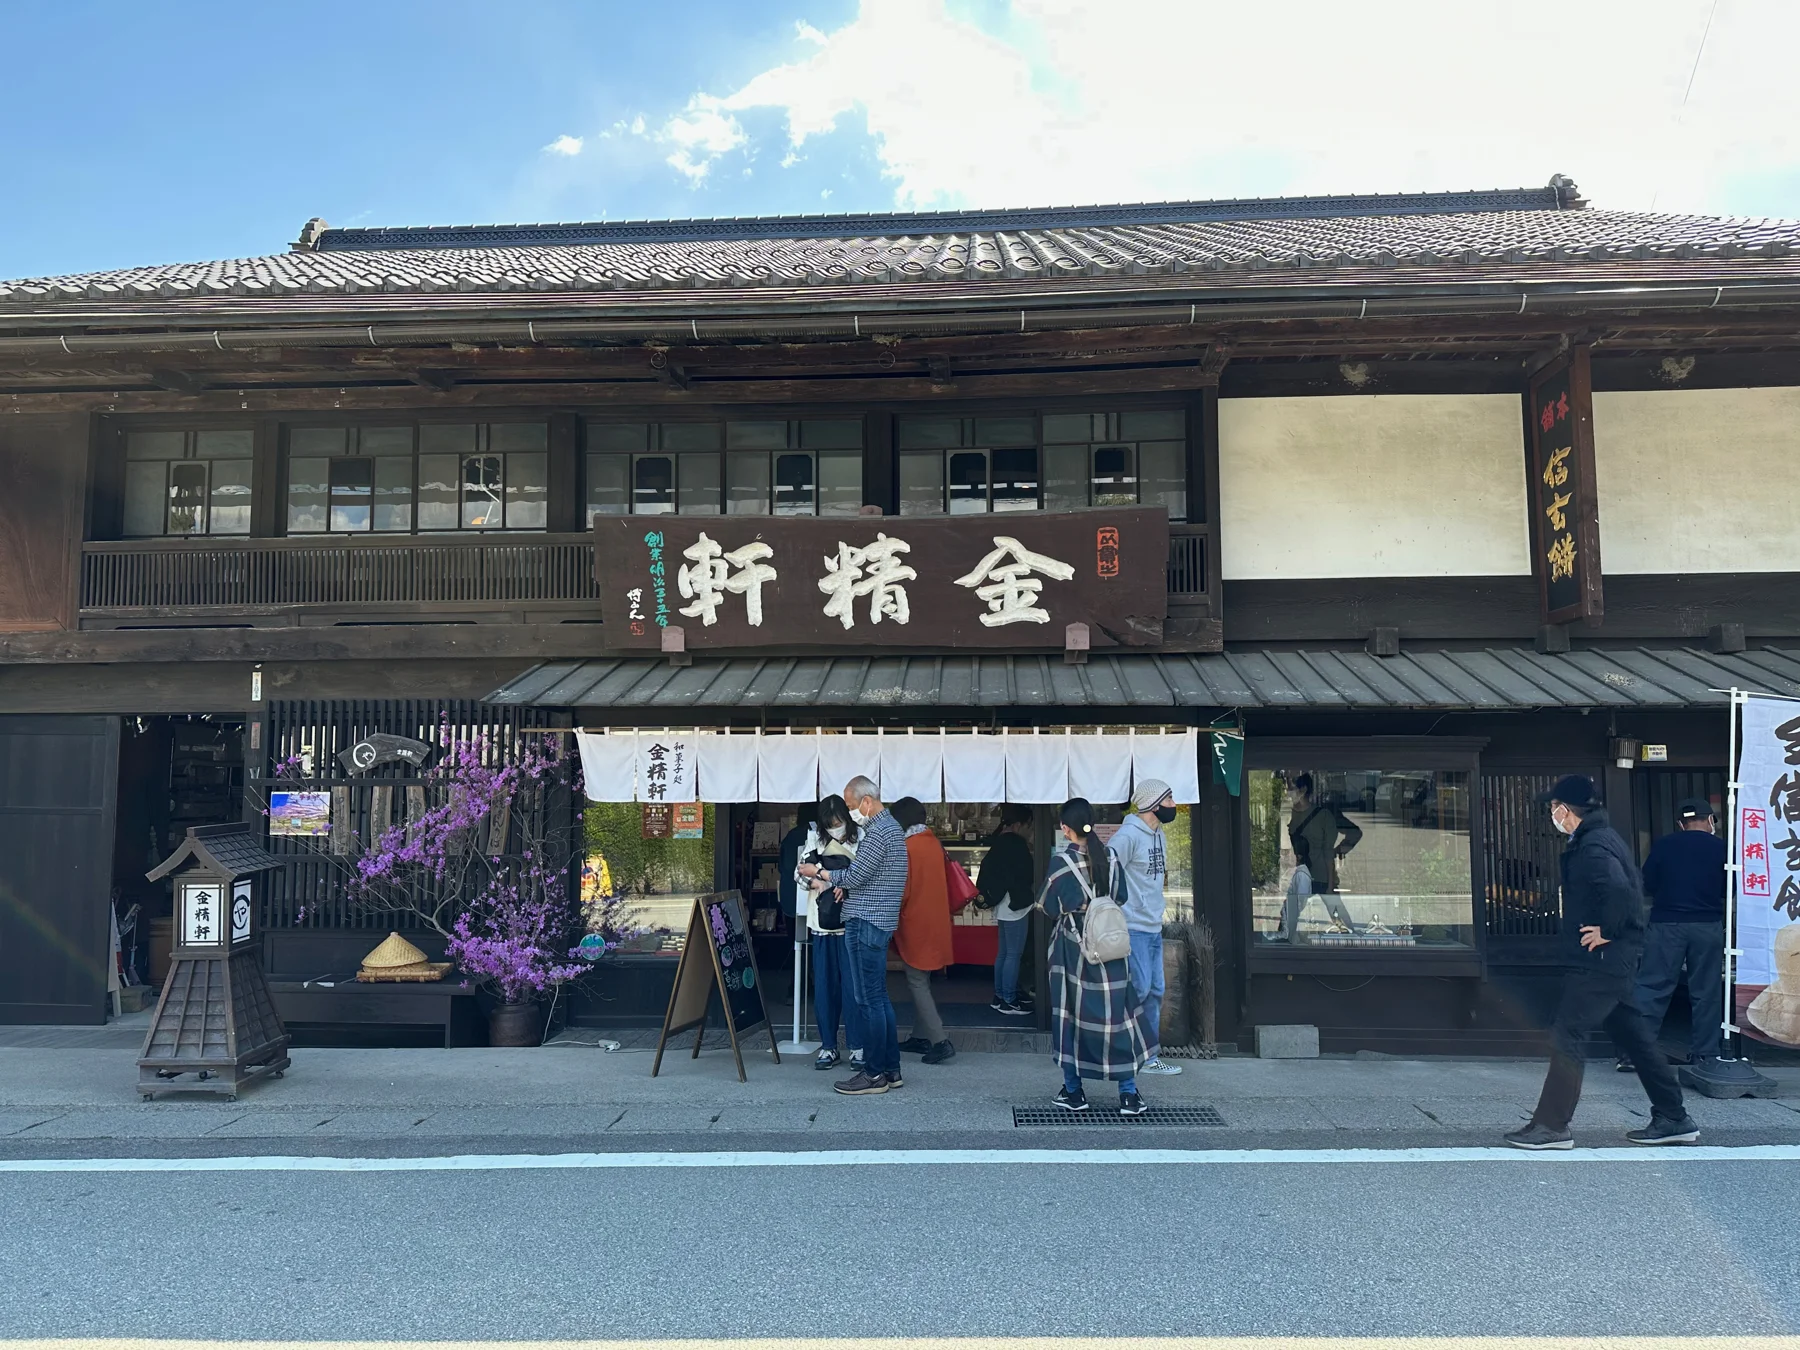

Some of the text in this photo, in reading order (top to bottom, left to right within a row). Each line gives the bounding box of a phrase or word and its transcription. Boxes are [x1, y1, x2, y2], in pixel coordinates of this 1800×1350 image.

[1543, 446, 1578, 583] 信玄餅
[678, 531, 1075, 631] 金精軒
[647, 743, 670, 801] 金精軒
[673, 742, 684, 785] 和菓子処
[1745, 812, 1767, 891] 金精軒
[194, 890, 212, 940] 金精軒
[235, 906, 246, 922] や
